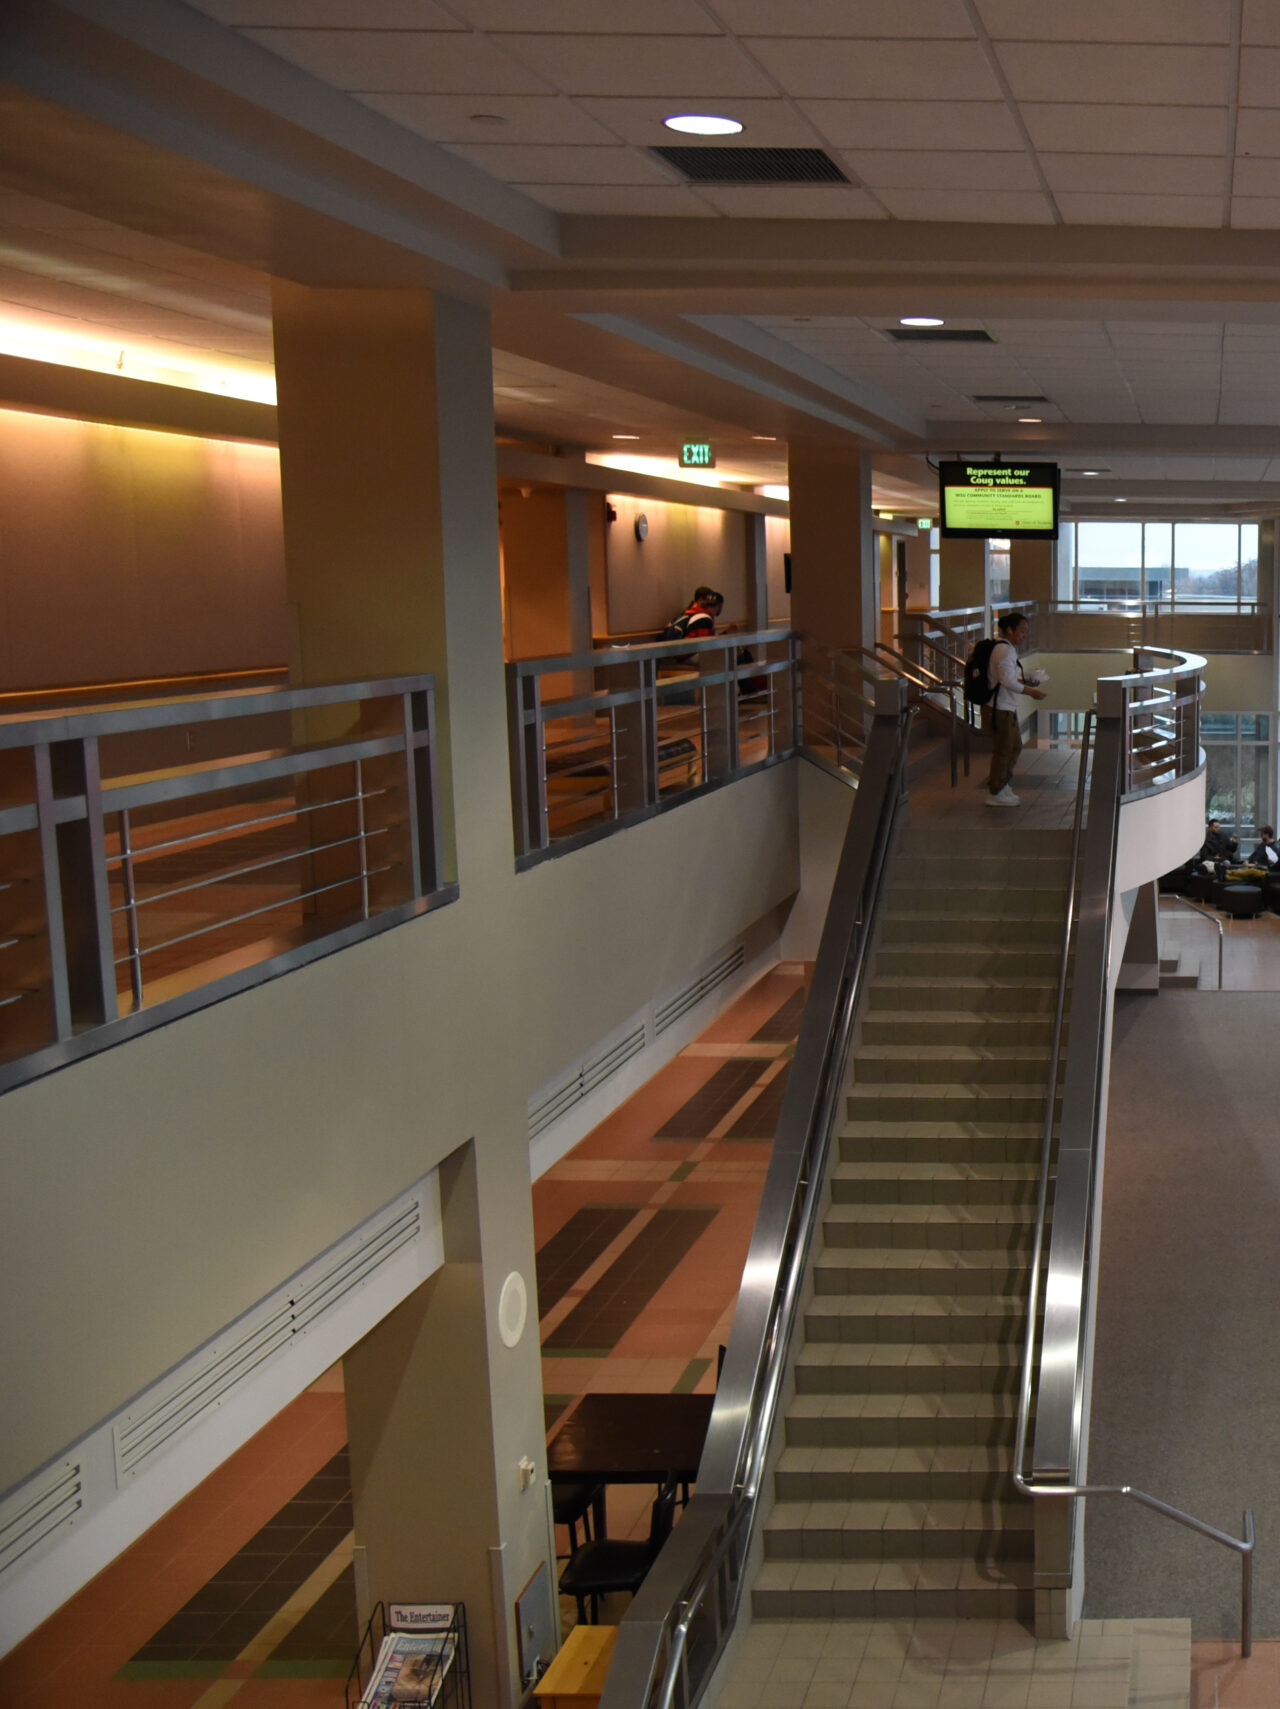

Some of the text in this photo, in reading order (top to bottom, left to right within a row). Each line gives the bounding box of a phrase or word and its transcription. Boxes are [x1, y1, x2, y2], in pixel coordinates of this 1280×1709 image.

[683, 443, 710, 464] EXIT
[966, 467, 1030, 477] Represent our
[970, 476, 1027, 486] Coug values.
[395, 1611, 450, 1623] The Entertainer
